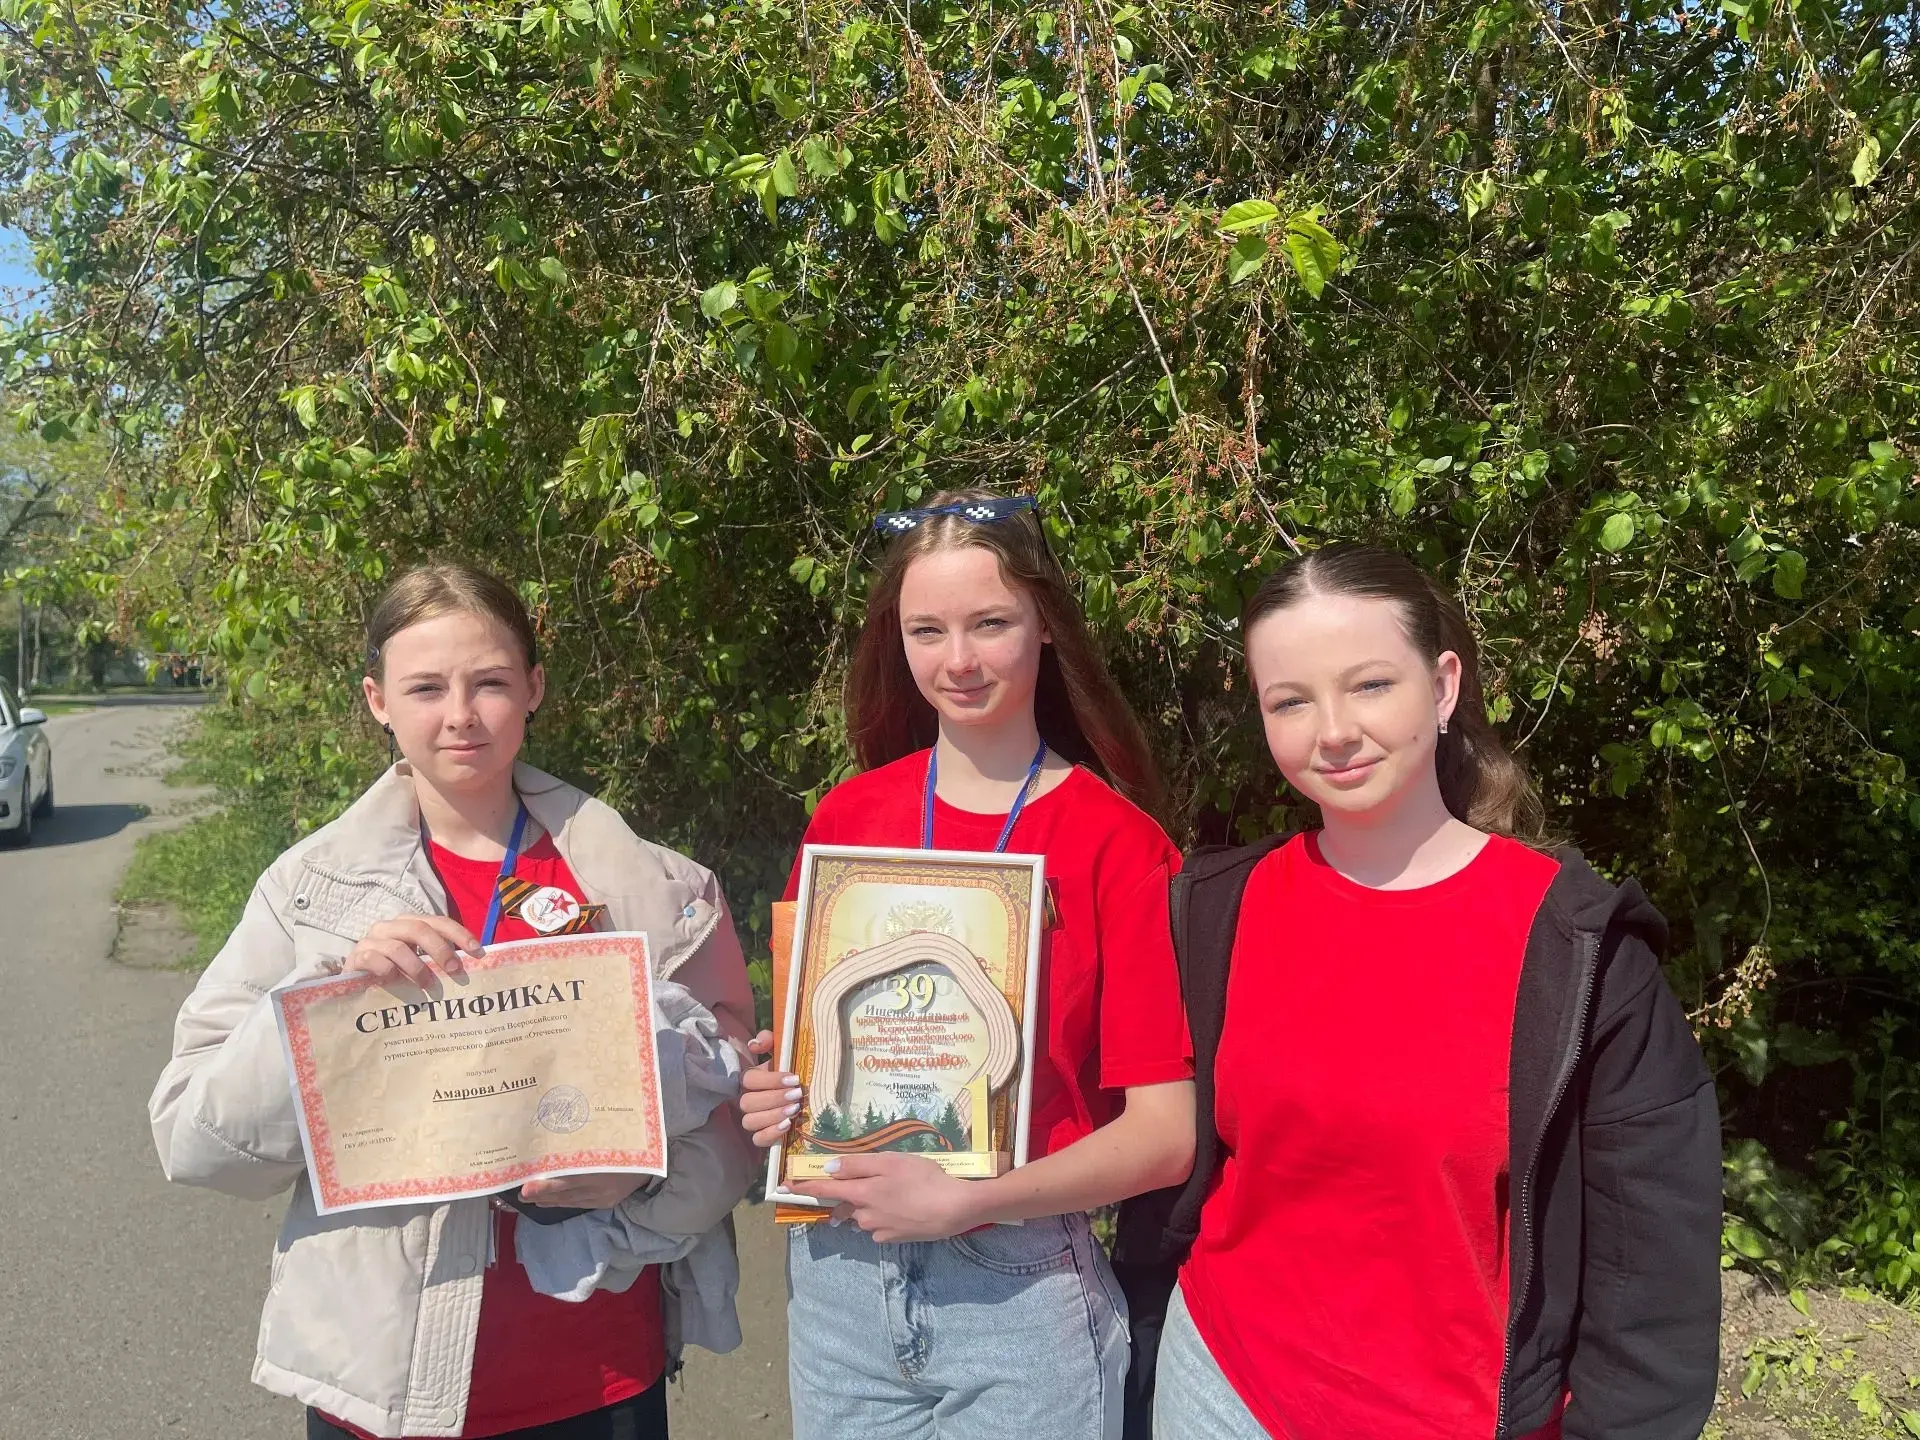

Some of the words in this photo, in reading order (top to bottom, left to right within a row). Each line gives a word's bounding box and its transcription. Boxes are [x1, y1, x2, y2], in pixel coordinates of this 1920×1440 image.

[356, 980, 585, 1034] СЕРТИФИКАТ
[889, 973, 934, 1010] 39
[384, 1035, 424, 1048] участника
[425, 1033, 446, 1041] 39-го
[449, 1030, 482, 1039] краевого
[507, 1014, 568, 1030] Всероссийского
[485, 1036, 523, 1048] движения
[525, 1027, 572, 1039] «Отечество»
[433, 1085, 495, 1099] Амарова
[499, 1076, 537, 1091] Анна
